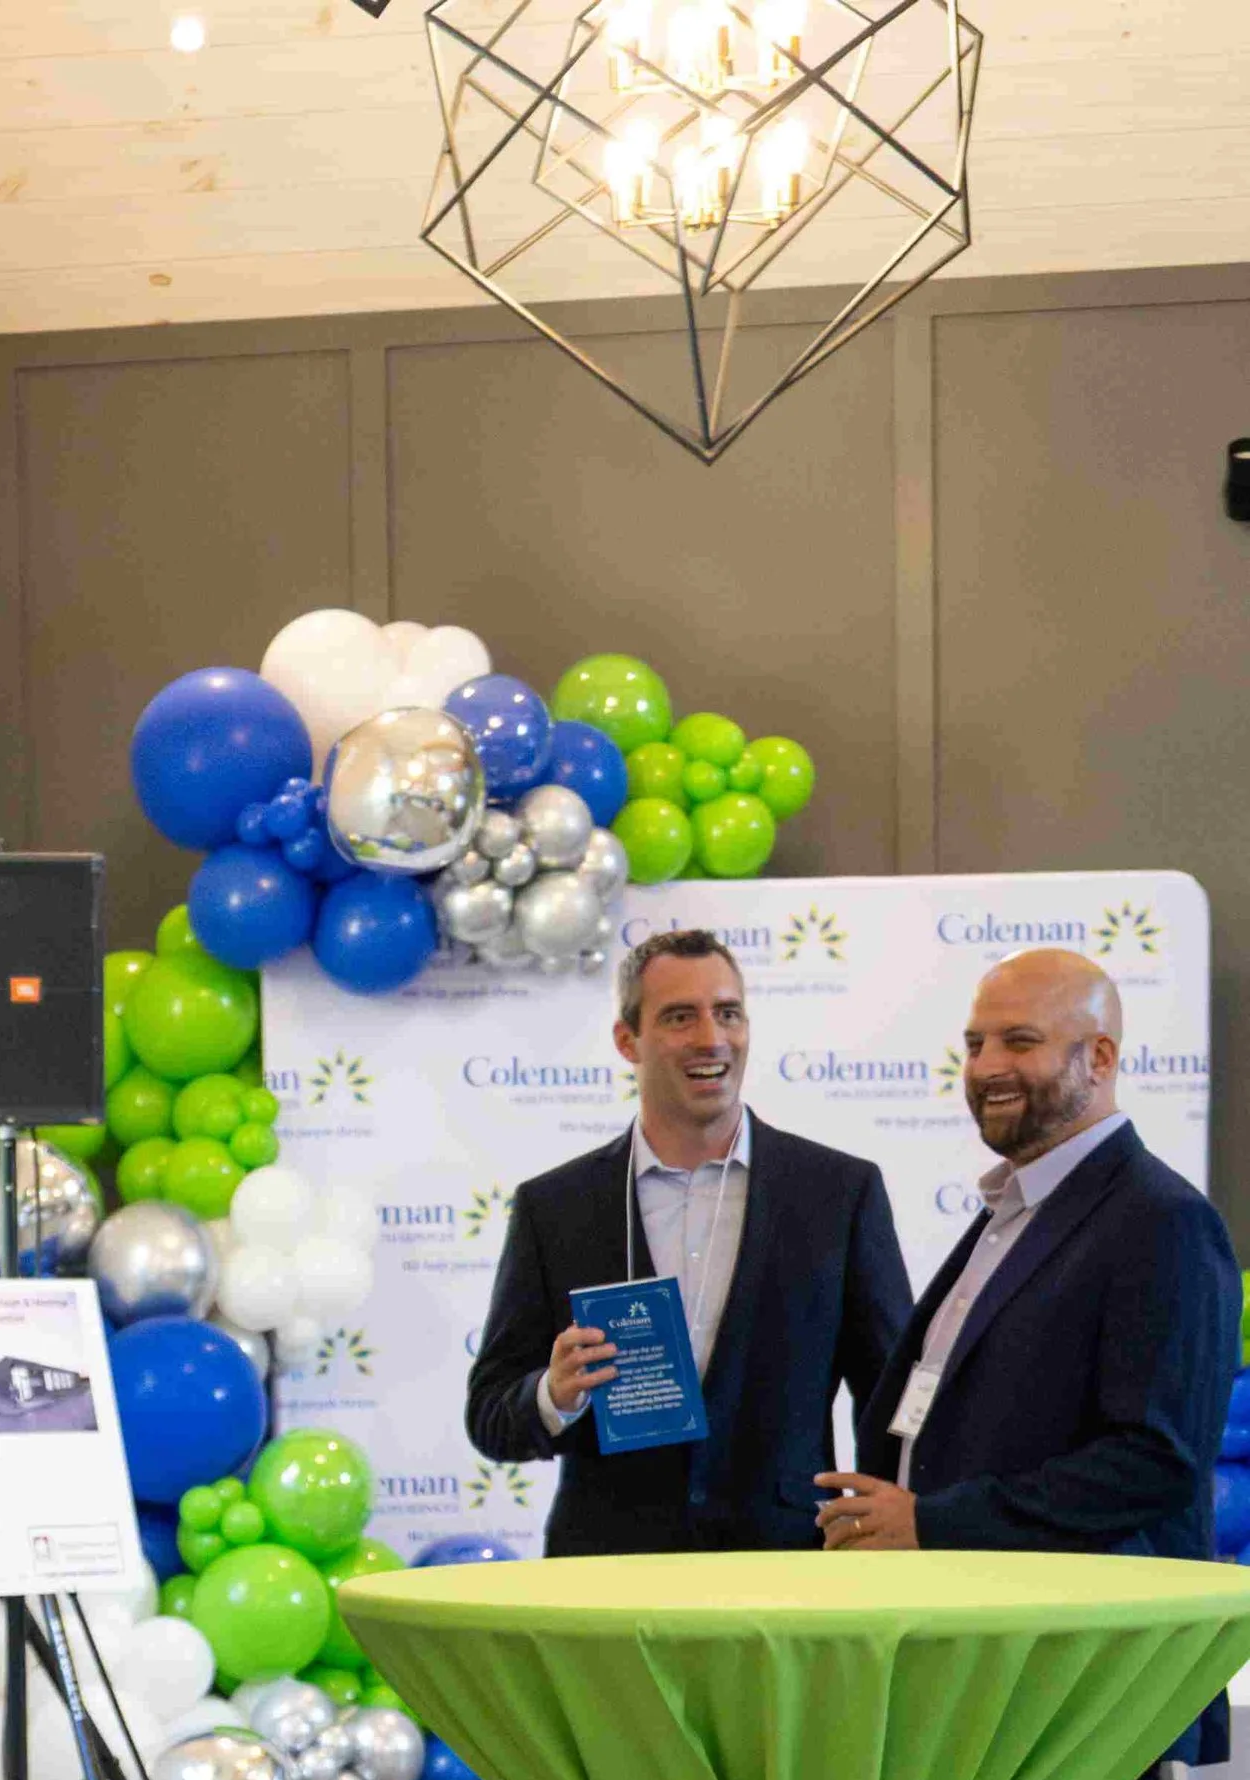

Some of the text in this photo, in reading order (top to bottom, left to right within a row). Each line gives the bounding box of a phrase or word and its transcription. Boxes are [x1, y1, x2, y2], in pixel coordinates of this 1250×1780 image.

[937, 912, 1086, 944] Coleman
[463, 1055, 613, 1088] Coleman
[778, 1049, 928, 1082] Coleman
